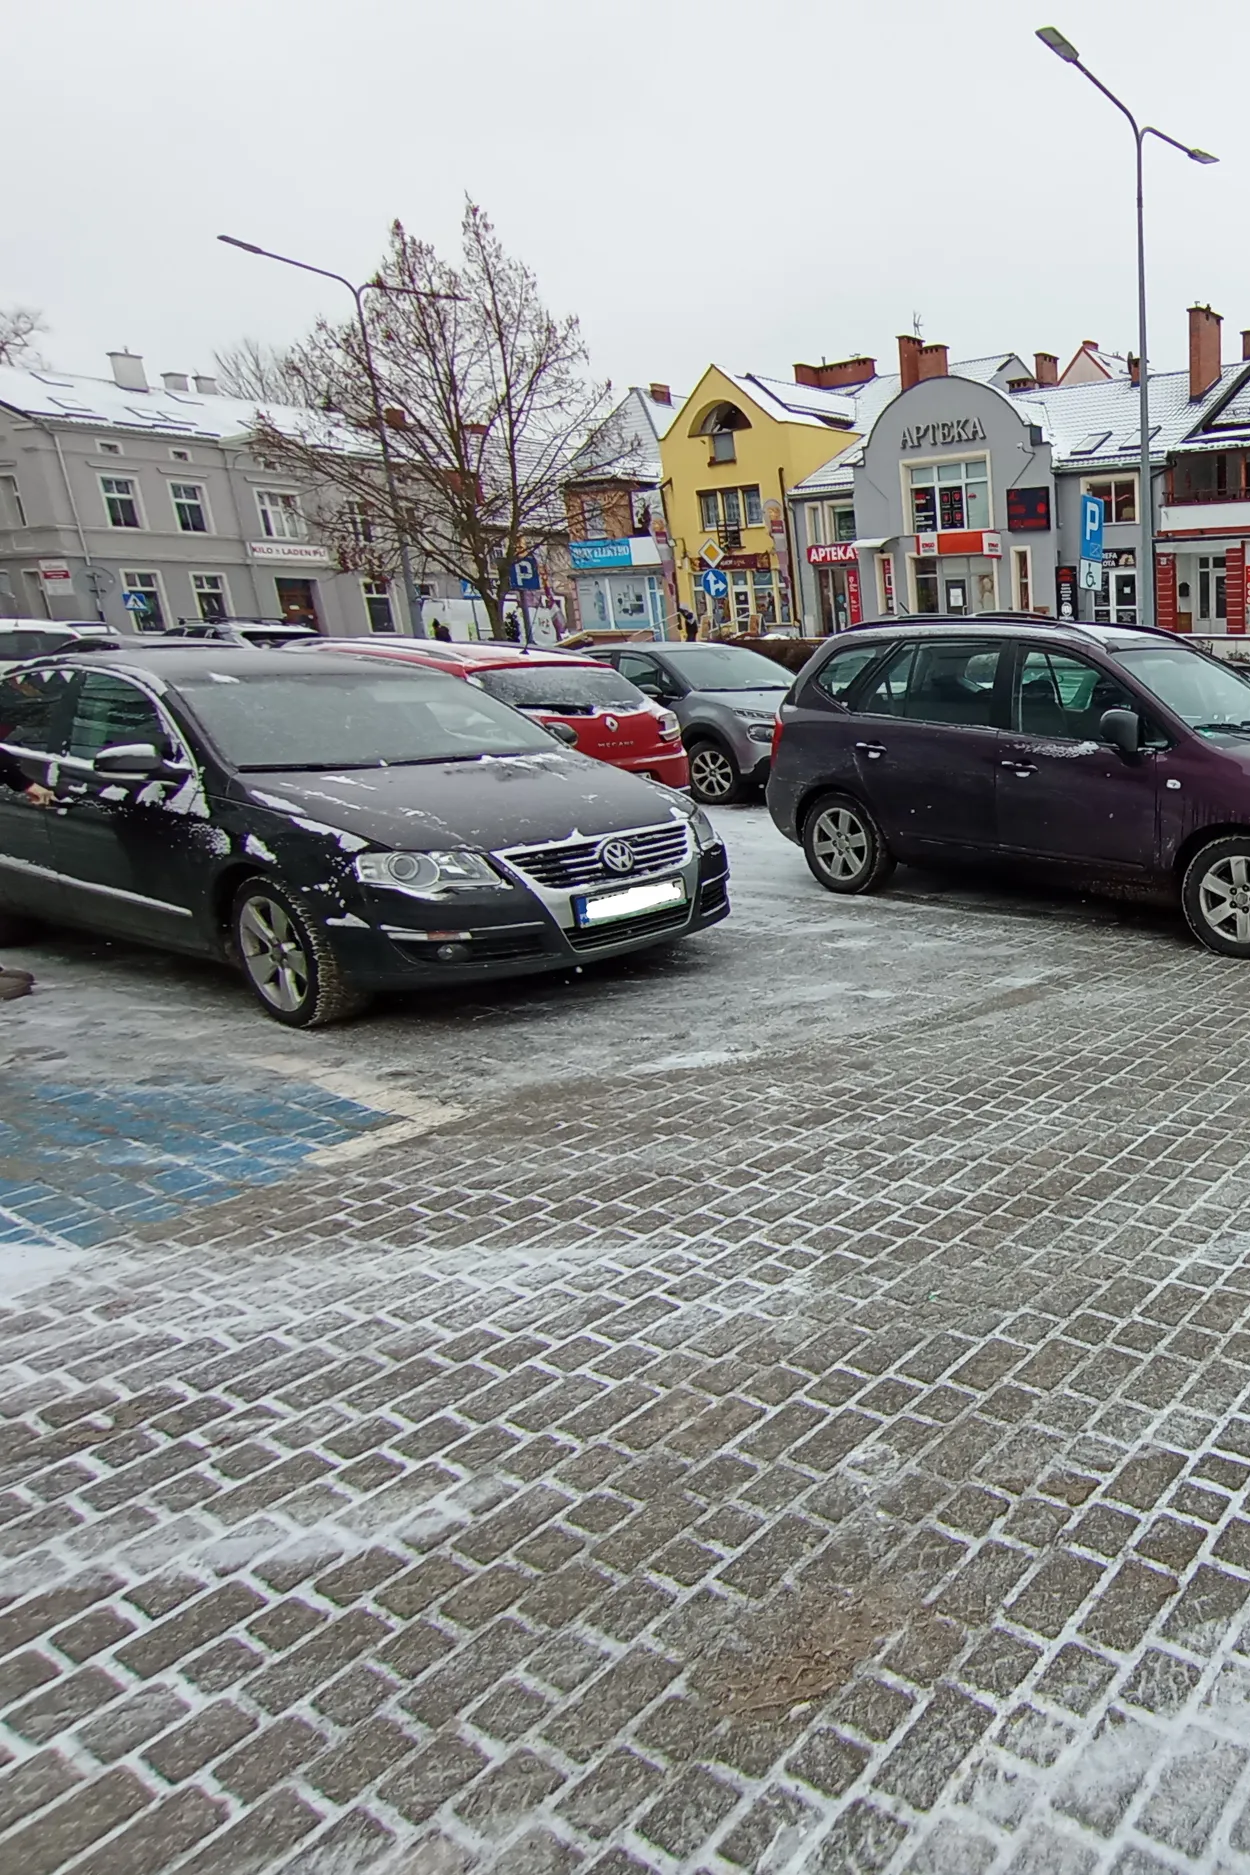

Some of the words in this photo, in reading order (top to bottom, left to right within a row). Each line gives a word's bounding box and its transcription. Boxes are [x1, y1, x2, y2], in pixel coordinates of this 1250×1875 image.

[900, 416, 987, 450] APTEKA
[1085, 501, 1100, 541] P
[809, 546, 855, 562] APTEKA
[514, 560, 533, 586] P
